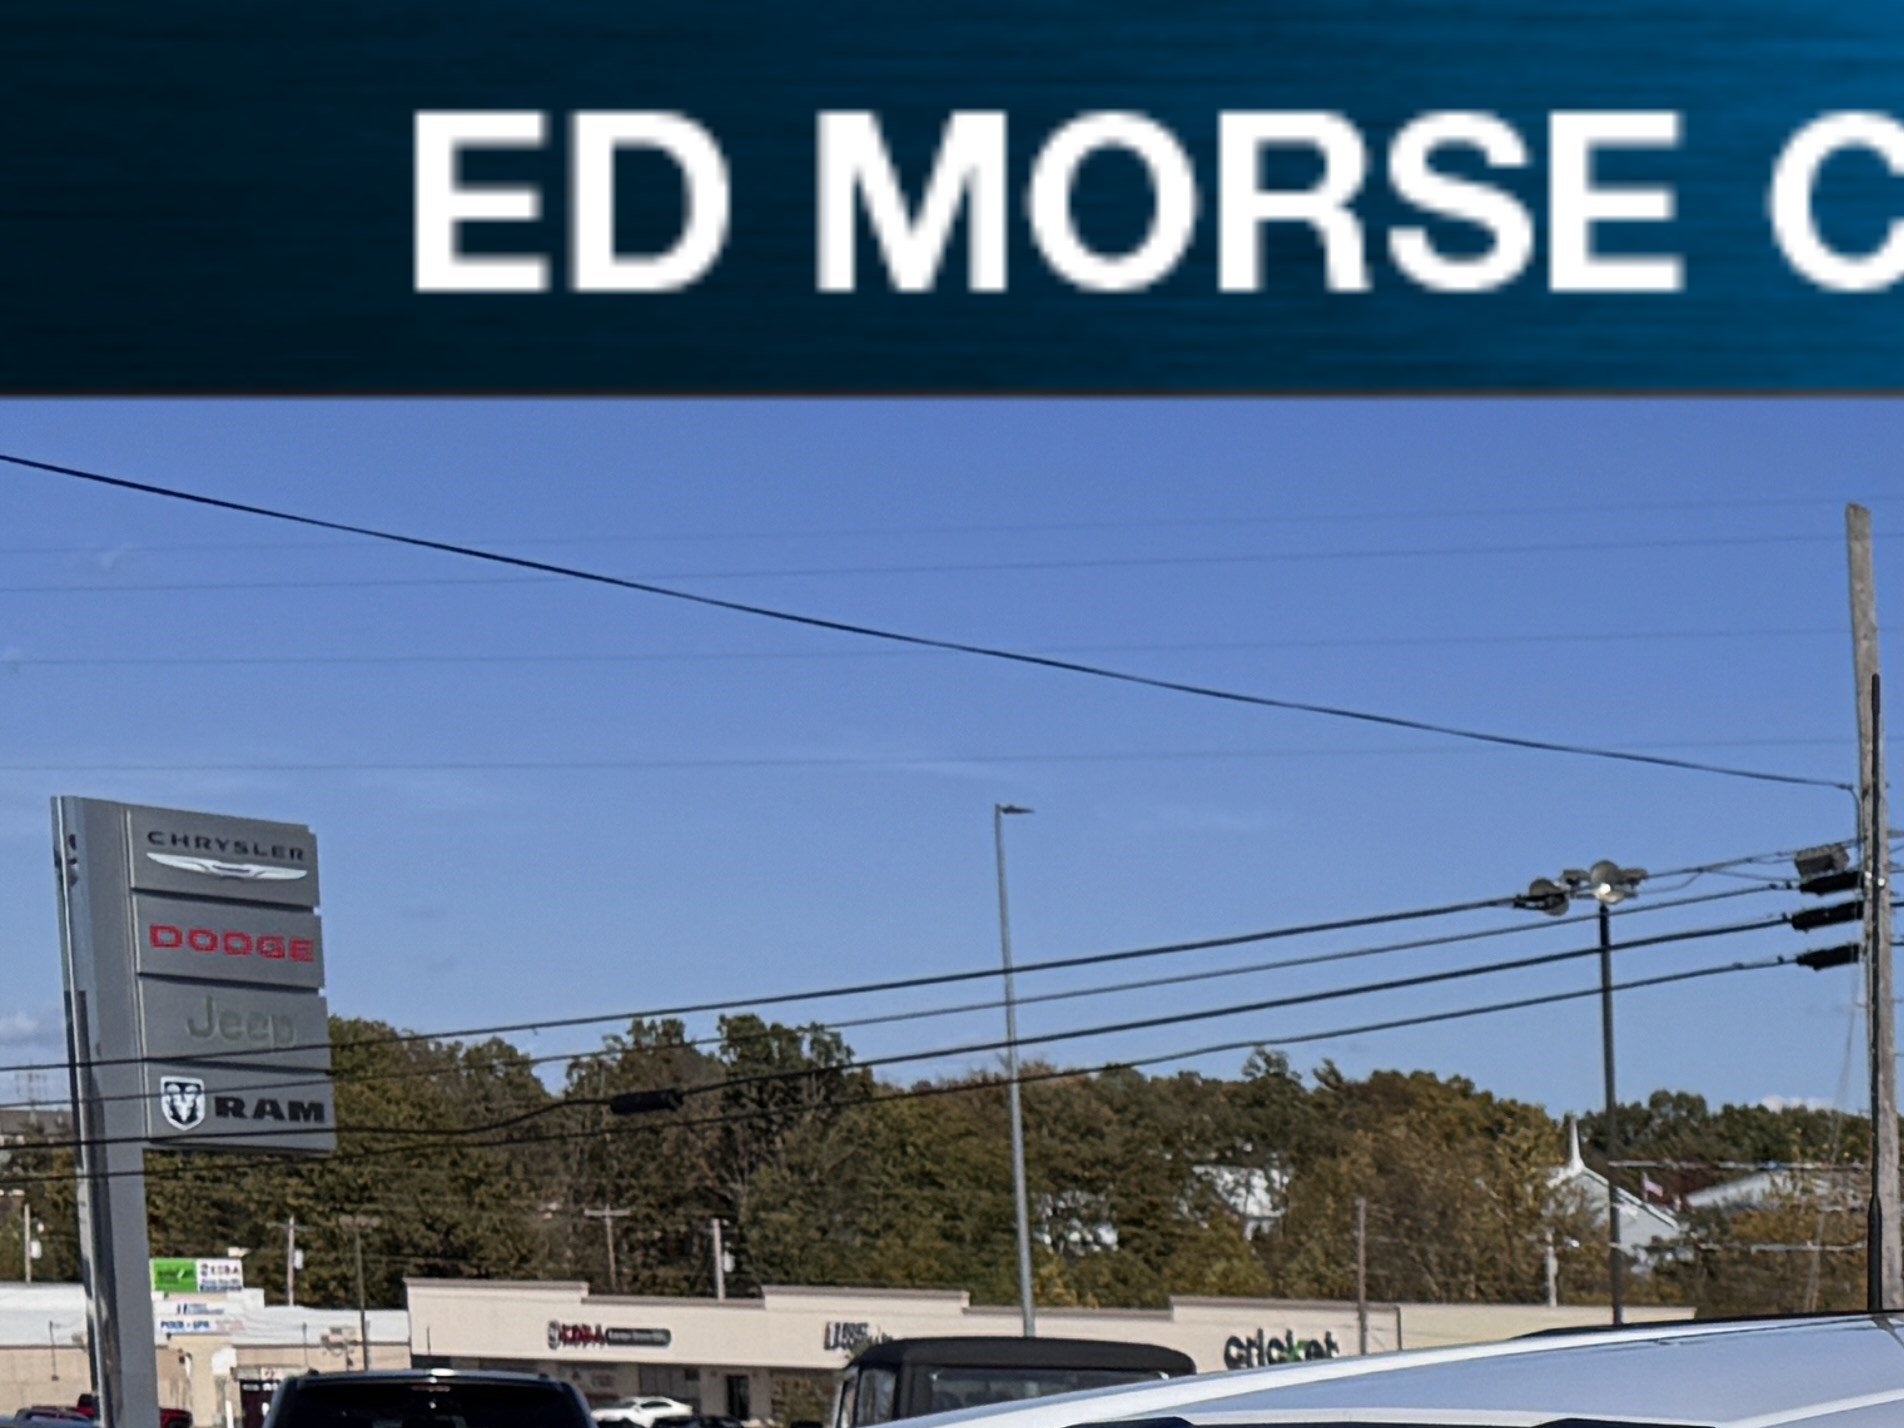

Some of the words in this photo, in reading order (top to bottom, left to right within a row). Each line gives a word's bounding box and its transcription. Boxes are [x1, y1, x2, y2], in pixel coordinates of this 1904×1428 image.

[147, 830, 304, 861] CHRYSLER
[149, 924, 314, 962] DODGE
[187, 995, 296, 1046] Jeep
[214, 1095, 325, 1123] RAM
